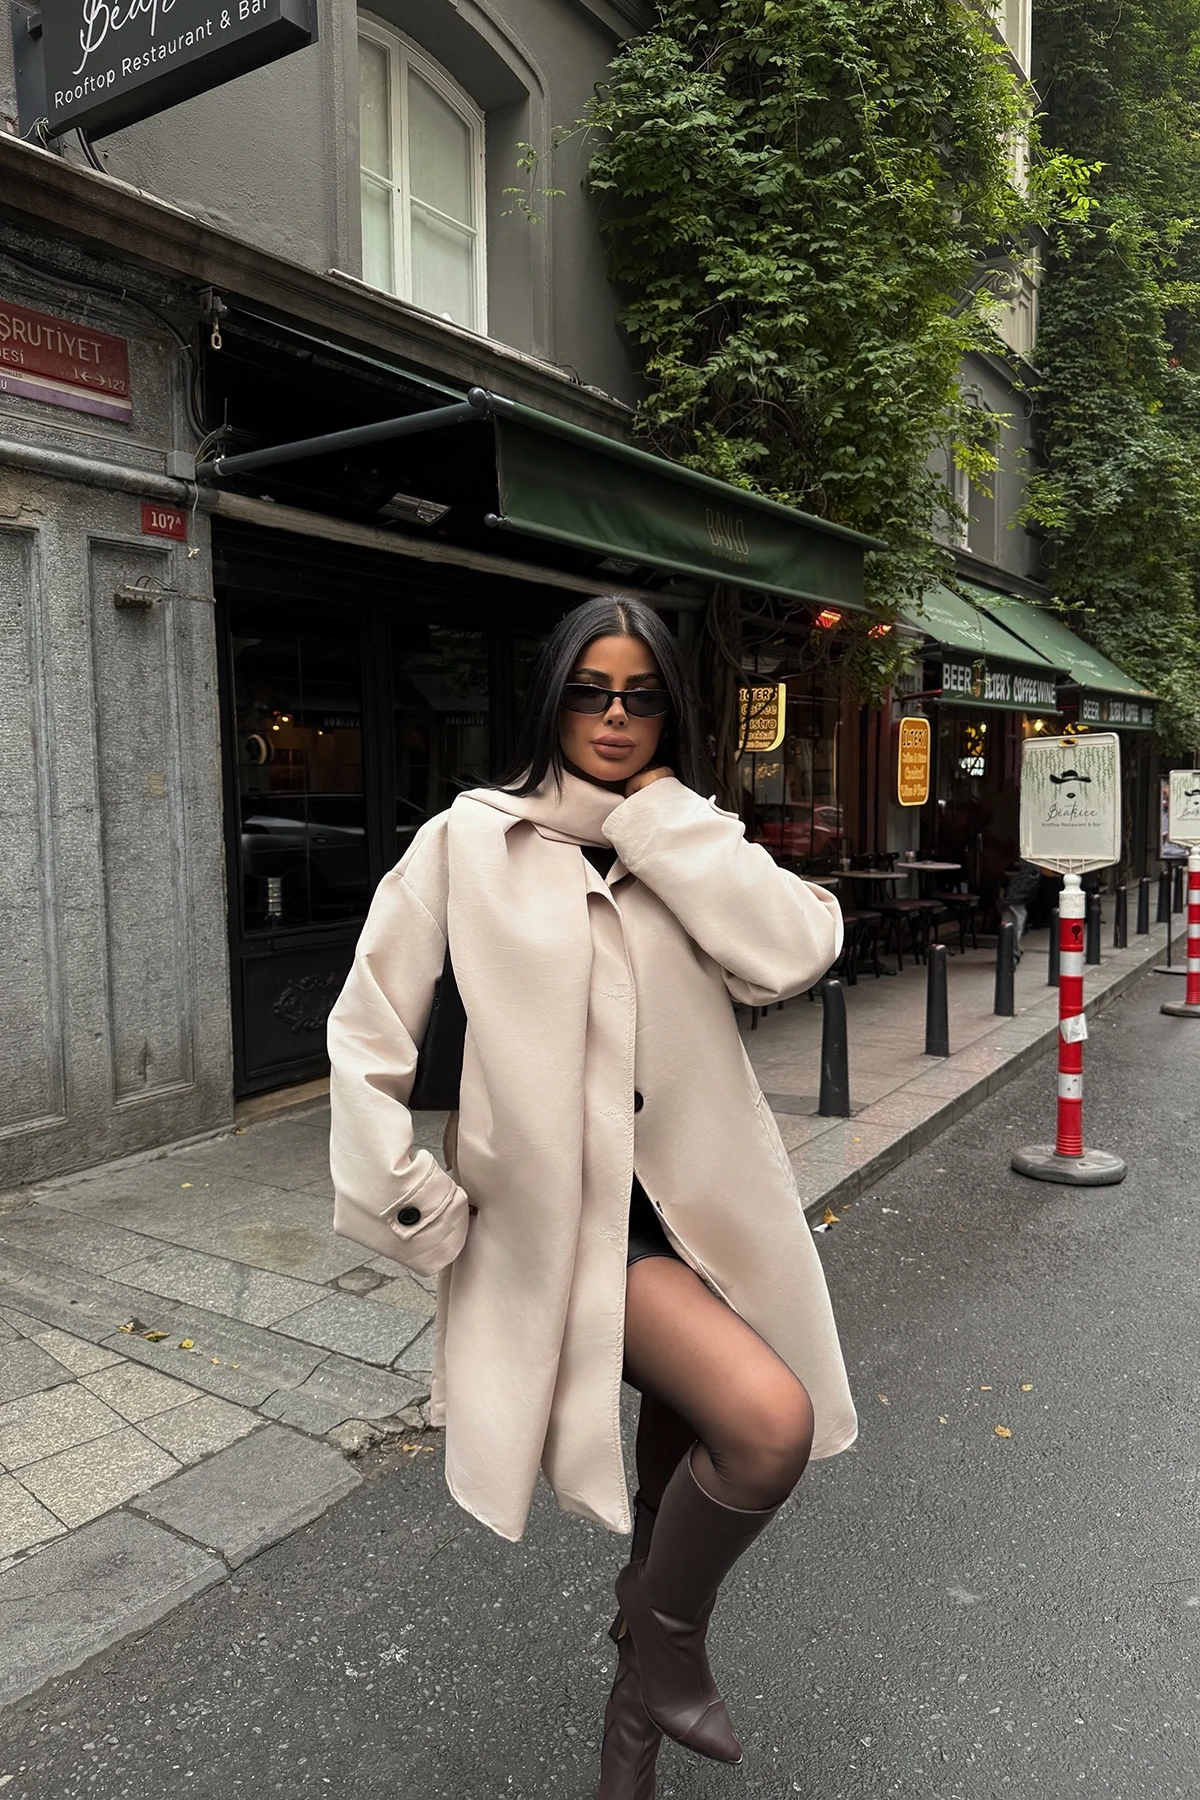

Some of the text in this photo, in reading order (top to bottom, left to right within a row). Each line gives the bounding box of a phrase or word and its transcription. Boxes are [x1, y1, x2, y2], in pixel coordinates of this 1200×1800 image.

[54, 0, 268, 109] Rooftop Restaurant & Bar
[73, 367, 126, 392] 1 127
[943, 662, 972, 692] BEER
[1083, 699, 1099, 721] BEER
